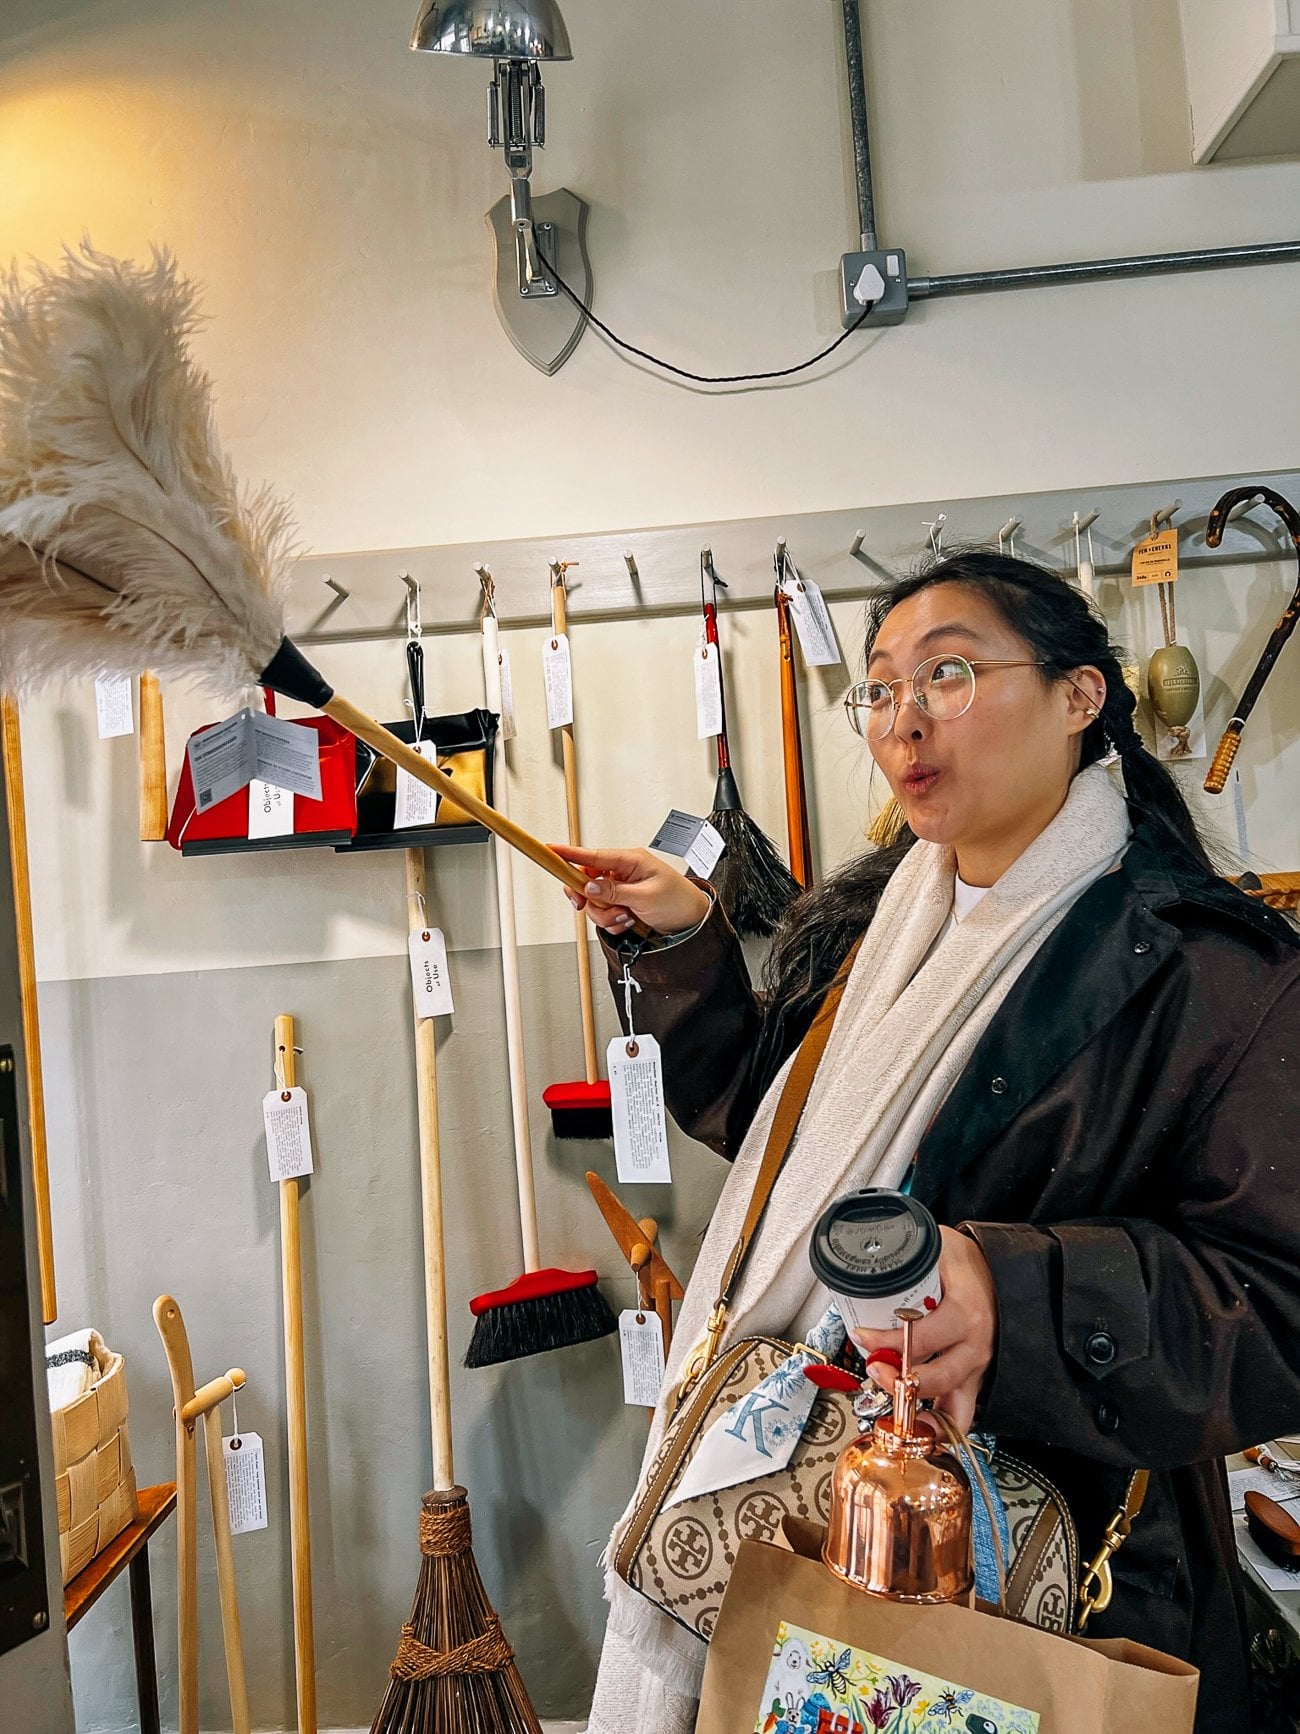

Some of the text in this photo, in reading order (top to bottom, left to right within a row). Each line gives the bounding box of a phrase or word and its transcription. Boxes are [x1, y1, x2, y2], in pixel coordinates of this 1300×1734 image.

[263, 782, 272, 814] Object
[424, 960, 433, 993] Objects
[432, 964, 440, 979] Use
[724, 1392, 790, 1459] K
